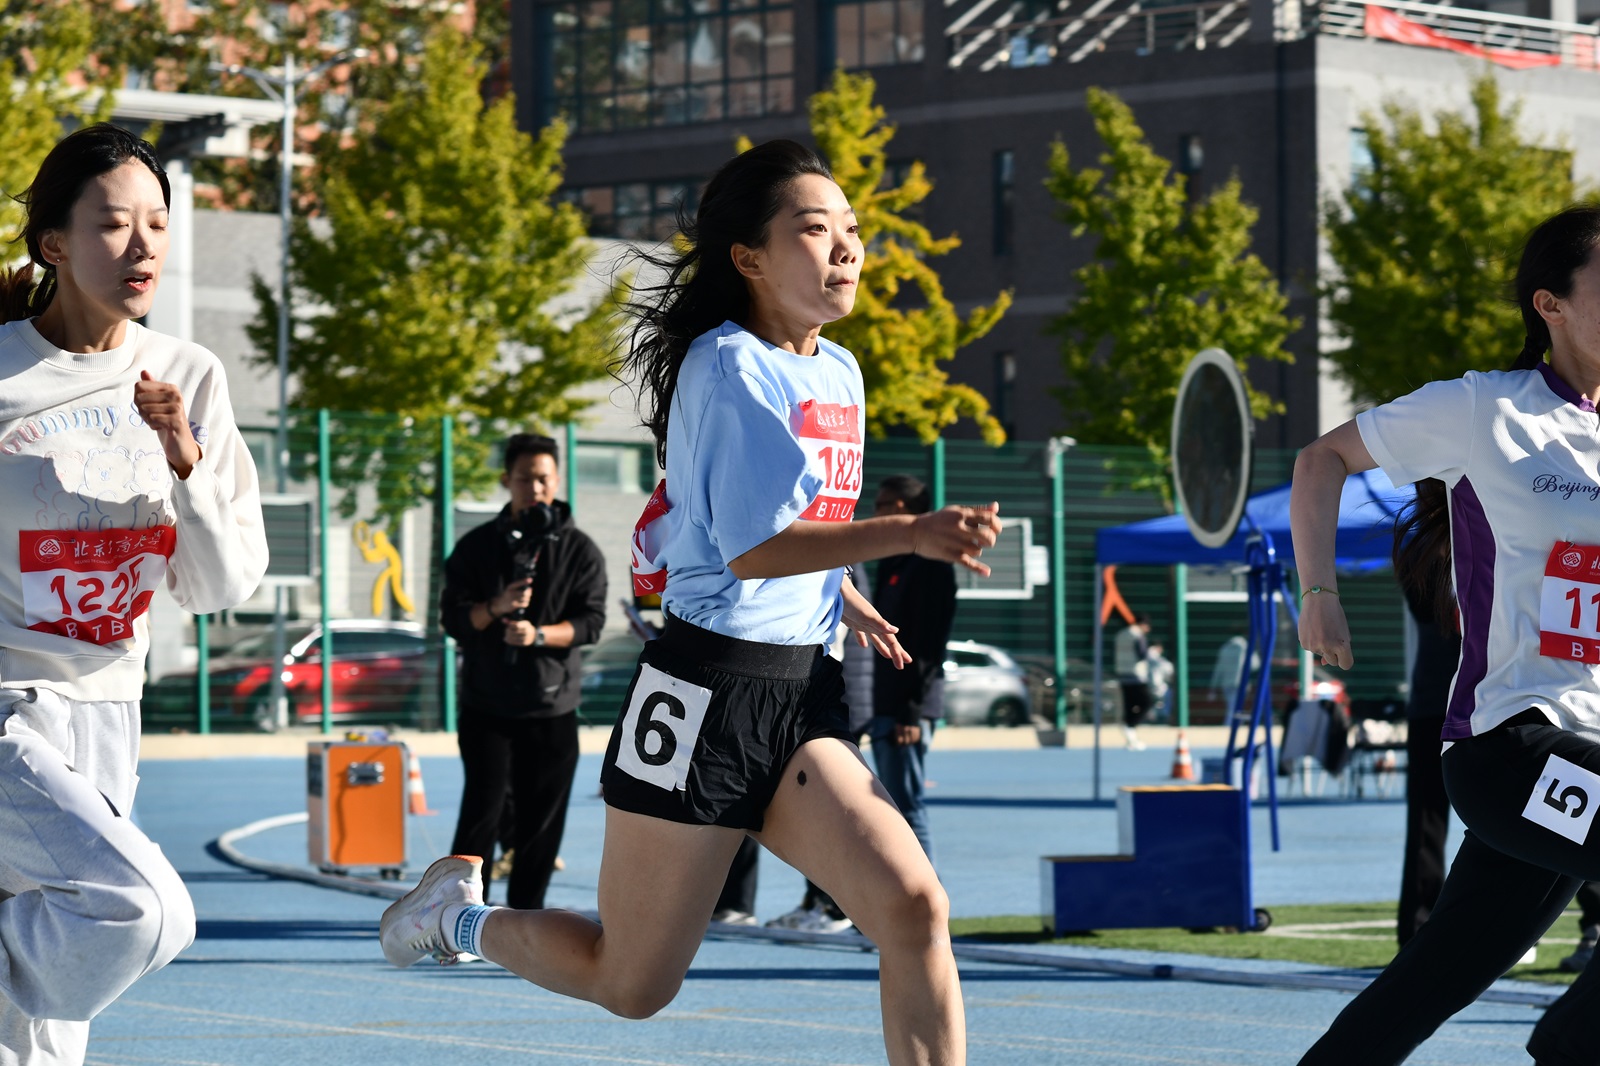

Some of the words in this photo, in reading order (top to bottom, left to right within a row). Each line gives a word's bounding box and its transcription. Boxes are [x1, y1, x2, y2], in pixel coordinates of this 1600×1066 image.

[818, 447, 862, 492] 1823
[1532, 473, 1600, 501] Beijing
[50, 556, 145, 616] 1225
[634, 690, 686, 767] 6
[1543, 778, 1589, 819] 5
